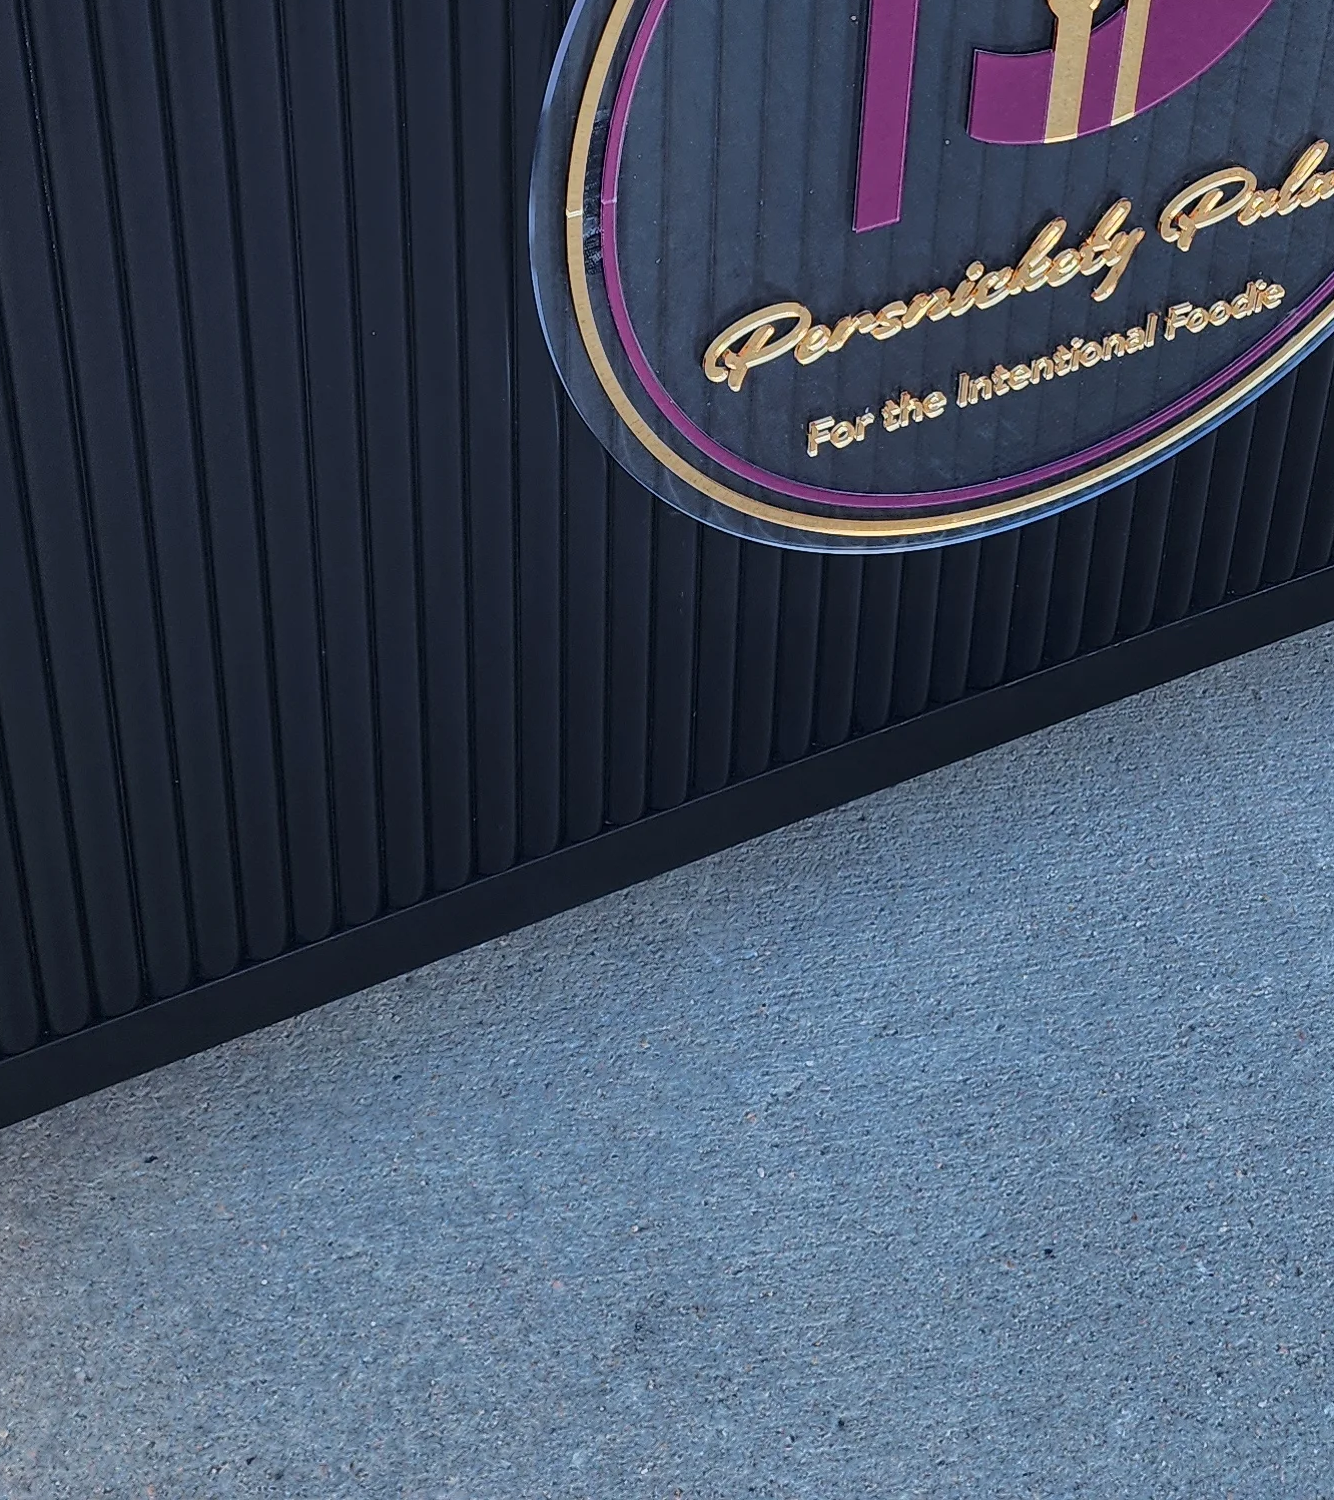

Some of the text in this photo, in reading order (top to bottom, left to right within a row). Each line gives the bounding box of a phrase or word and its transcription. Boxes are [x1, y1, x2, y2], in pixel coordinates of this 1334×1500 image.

[703, 198, 1146, 392] Persnickety
[807, 279, 1286, 457] For the Intentional Foodie
